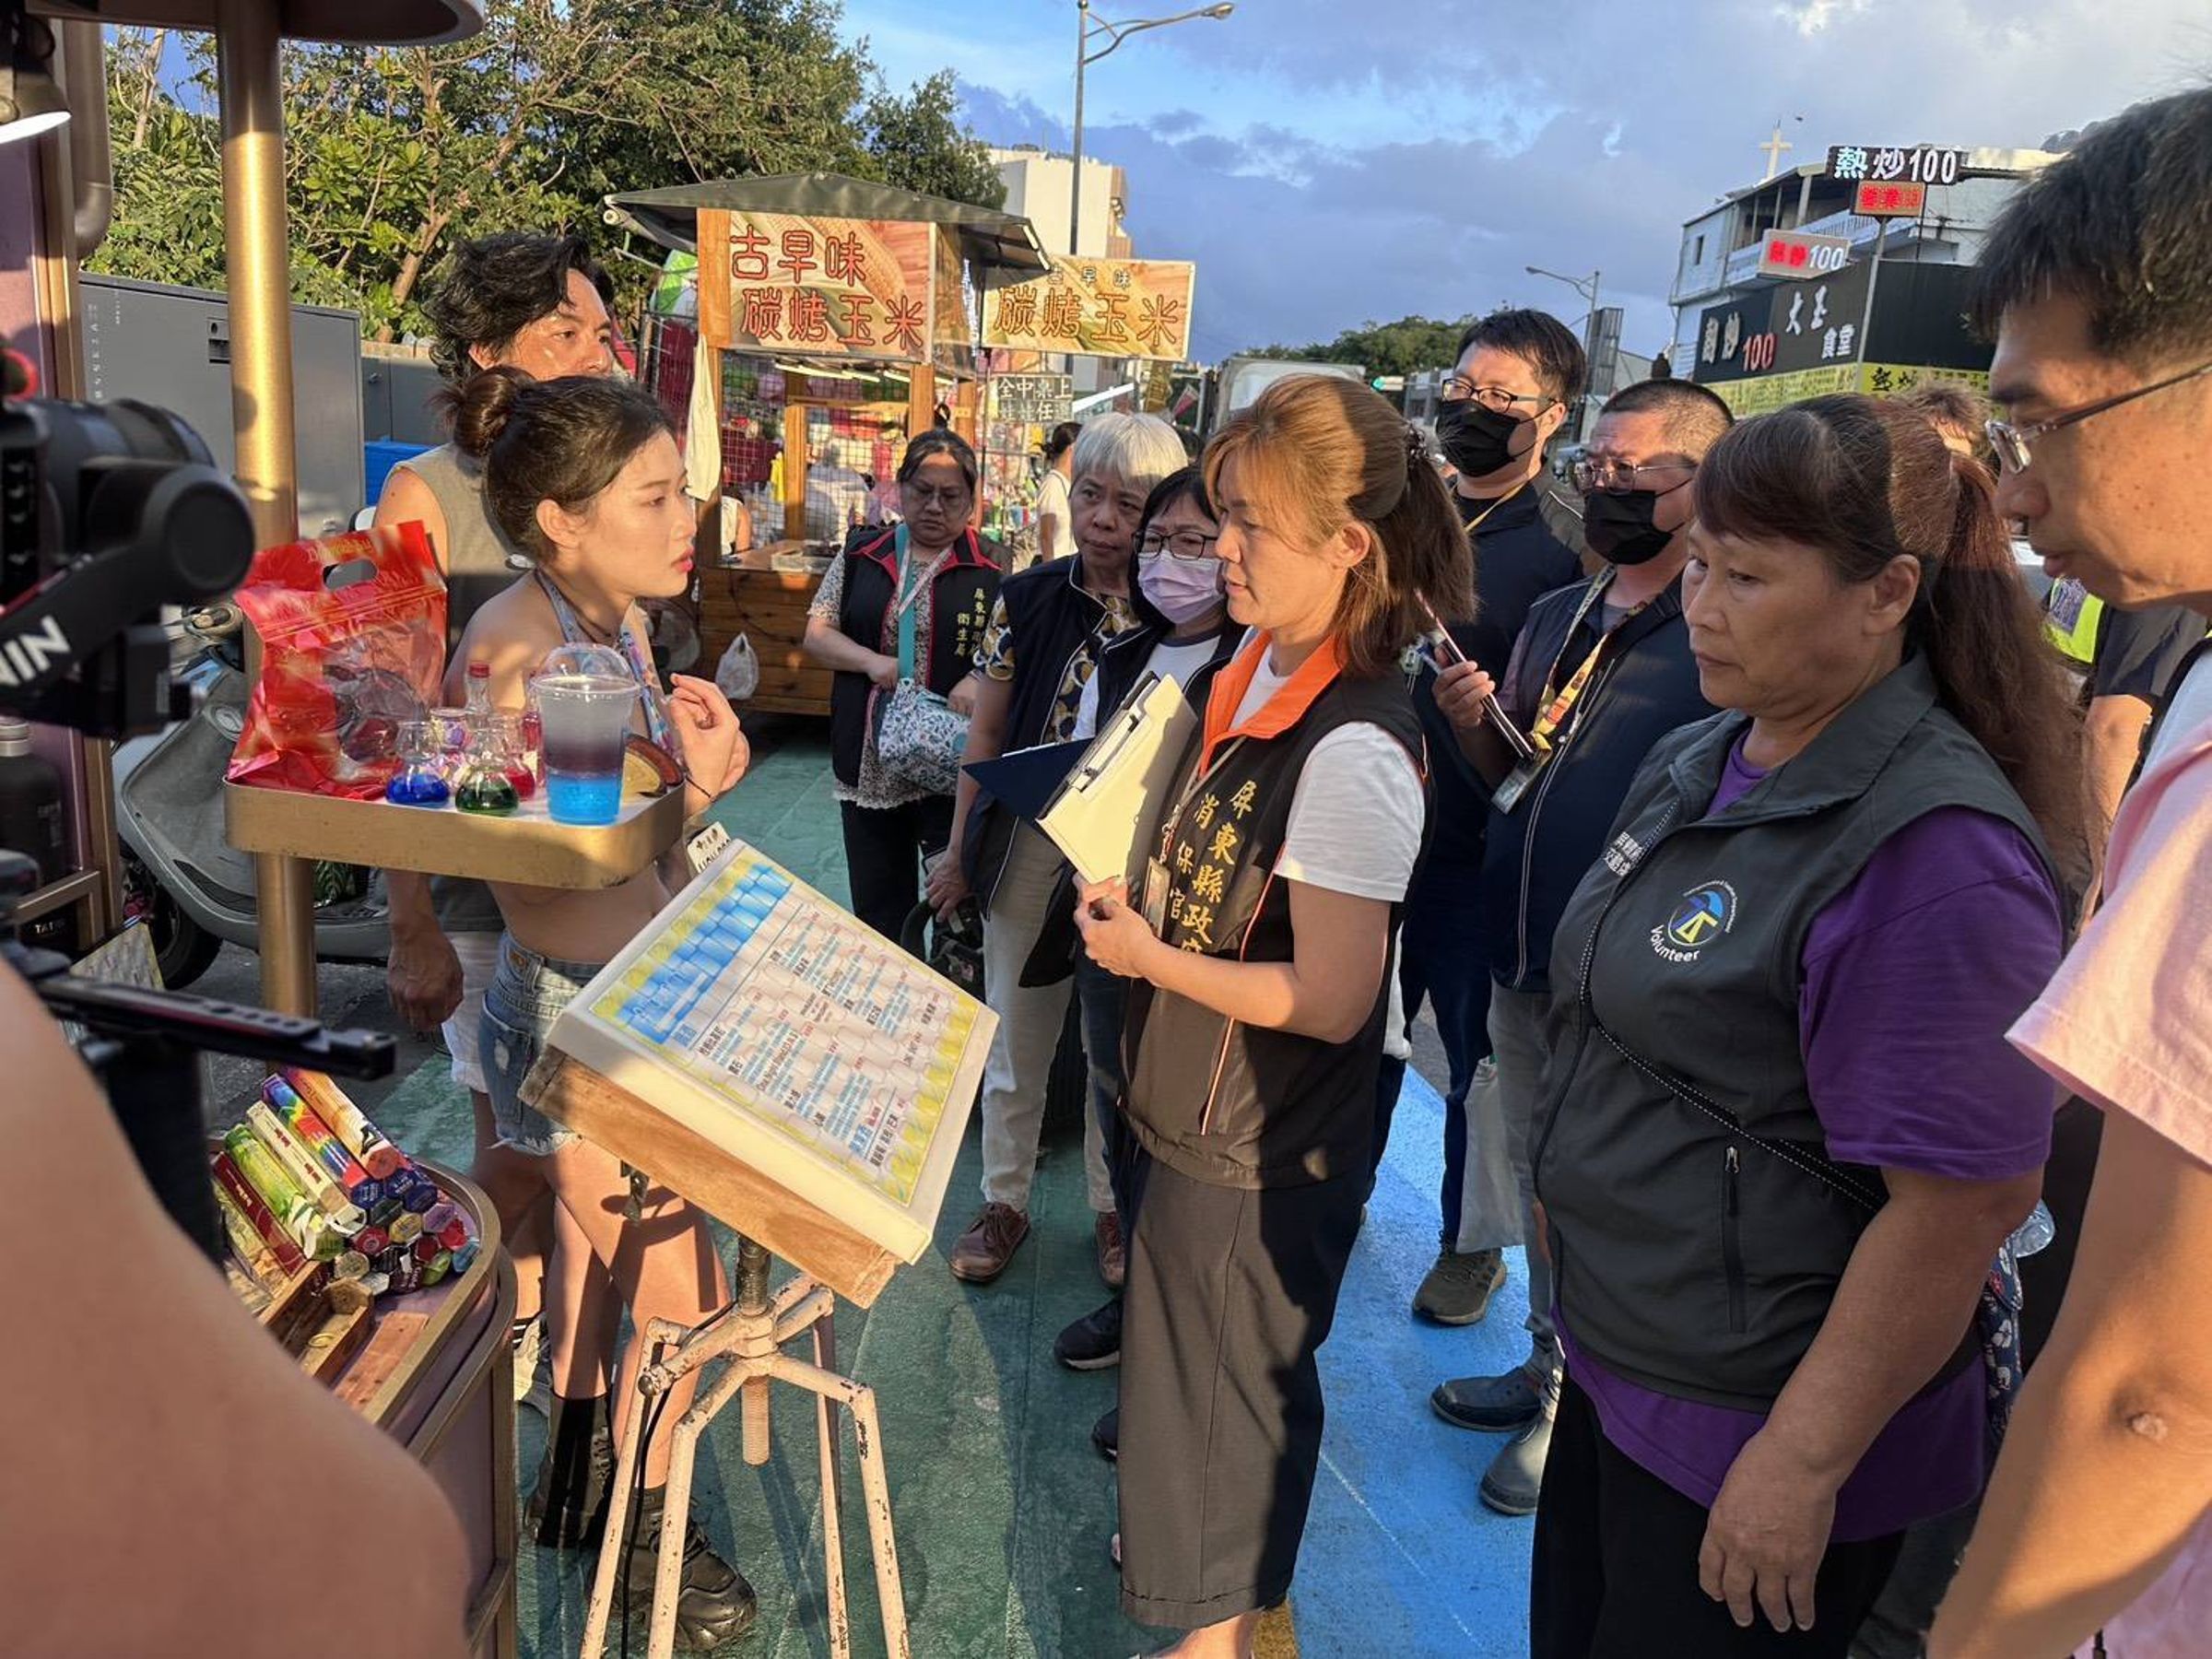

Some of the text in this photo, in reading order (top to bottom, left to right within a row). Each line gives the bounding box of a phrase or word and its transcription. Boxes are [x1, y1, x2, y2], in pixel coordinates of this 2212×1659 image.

[1834, 147, 1957, 183] 熱炒100
[730, 224, 867, 287] 古早味
[1047, 264, 1132, 290] 古早味
[740, 287, 924, 350] 碳烤玉米
[994, 285, 1179, 347] 碳烤玉米
[1742, 332, 1776, 372] 100
[1821, 323, 1856, 360] 食堂
[1650, 924, 1700, 962] Volunteer
